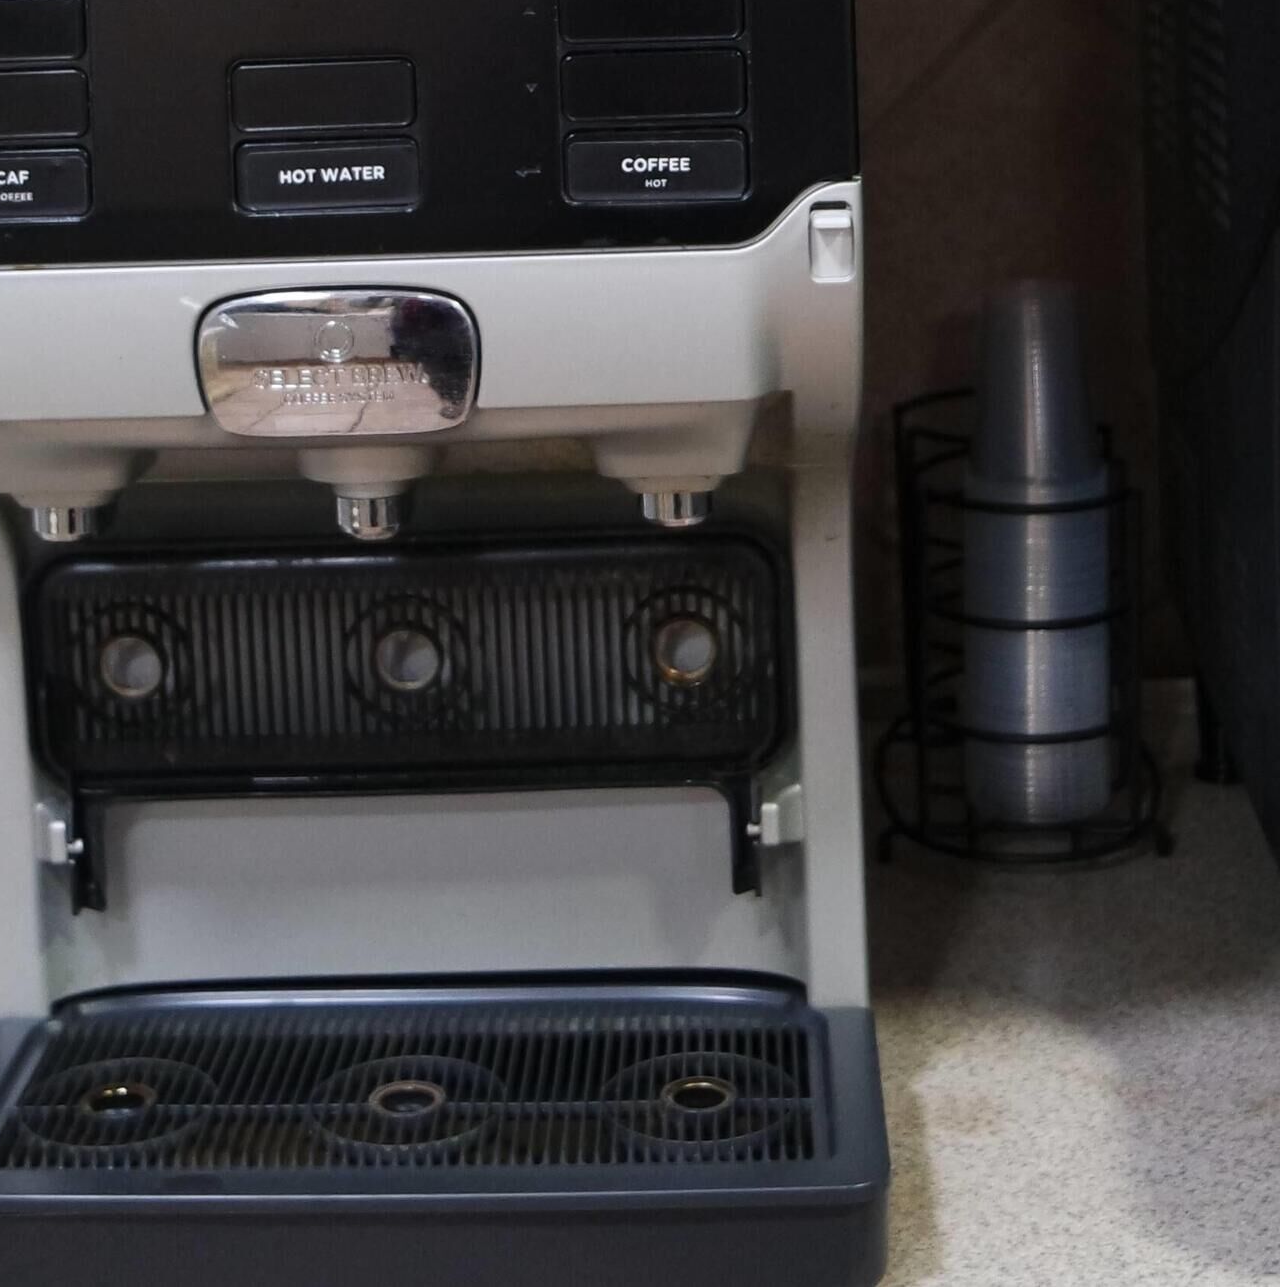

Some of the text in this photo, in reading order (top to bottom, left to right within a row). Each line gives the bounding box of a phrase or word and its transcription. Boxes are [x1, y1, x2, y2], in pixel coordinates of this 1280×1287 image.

[621, 157, 691, 173] COFFEE
[279, 166, 385, 184] HOT WATER
[645, 179, 668, 188] HOT
